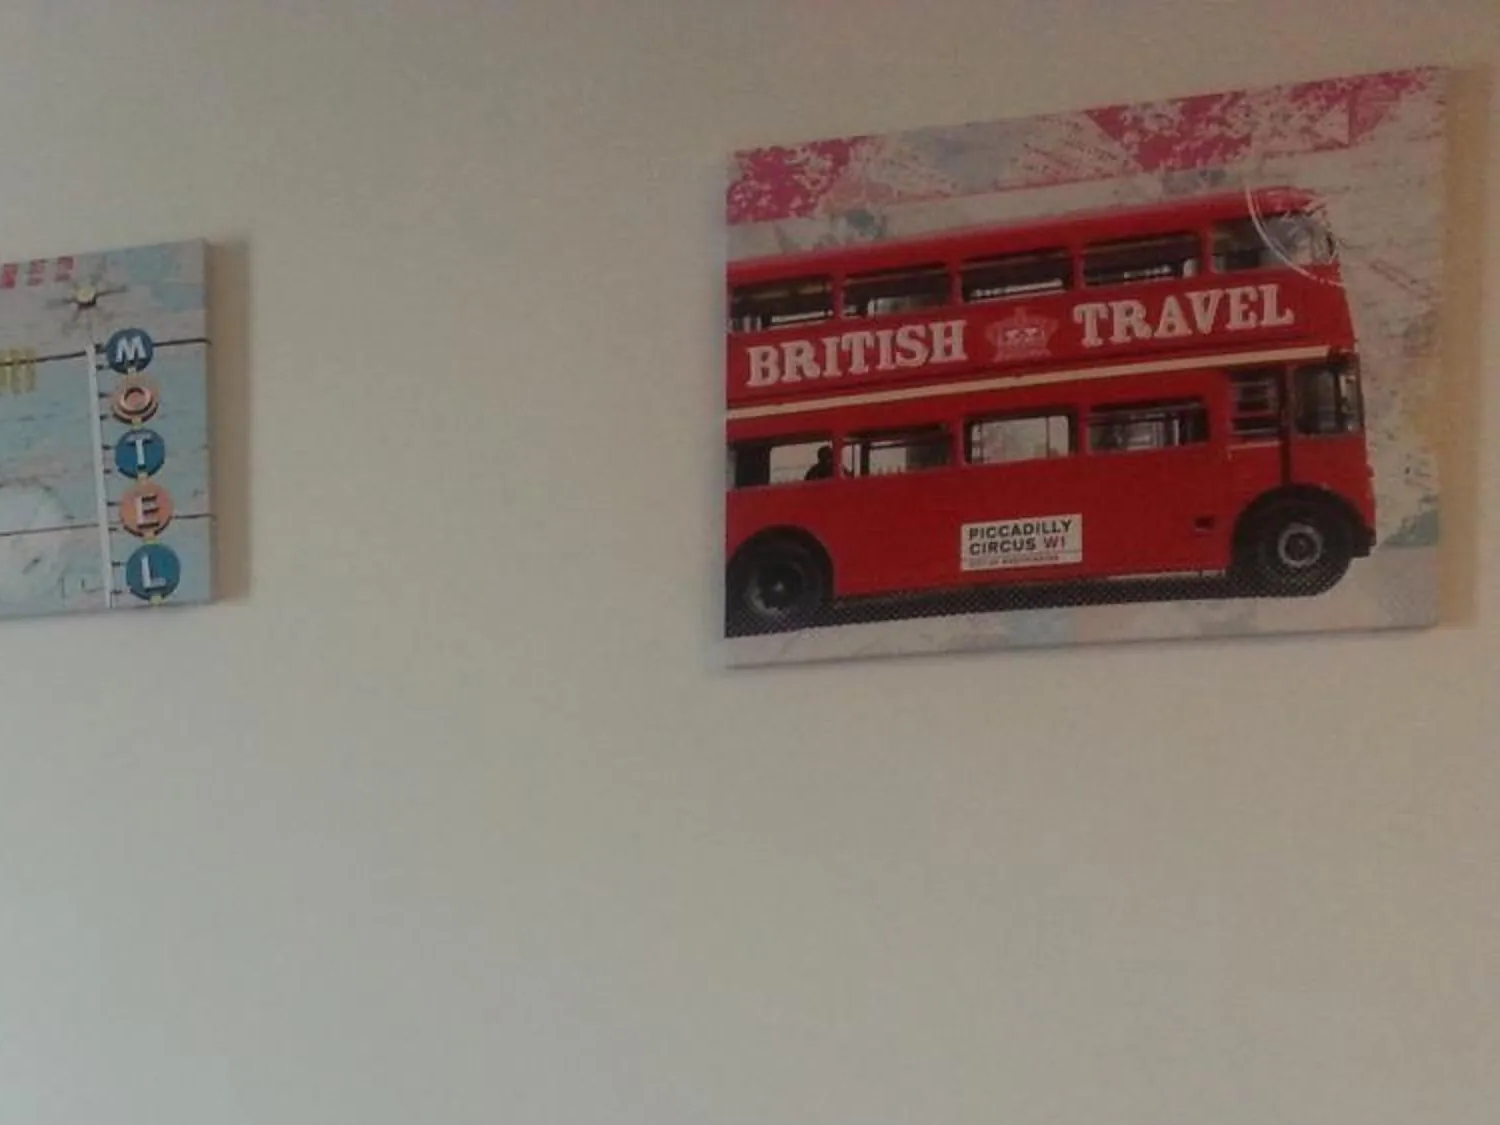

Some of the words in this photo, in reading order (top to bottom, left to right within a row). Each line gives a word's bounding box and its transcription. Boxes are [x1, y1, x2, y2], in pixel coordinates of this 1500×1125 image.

[746, 320, 968, 387] BRITISH
[1073, 284, 1295, 348] TRAVEL
[113, 334, 168, 590] MOTEL
[969, 519, 1071, 540] PICCADILLY
[969, 538, 1037, 555] CIRCUS
